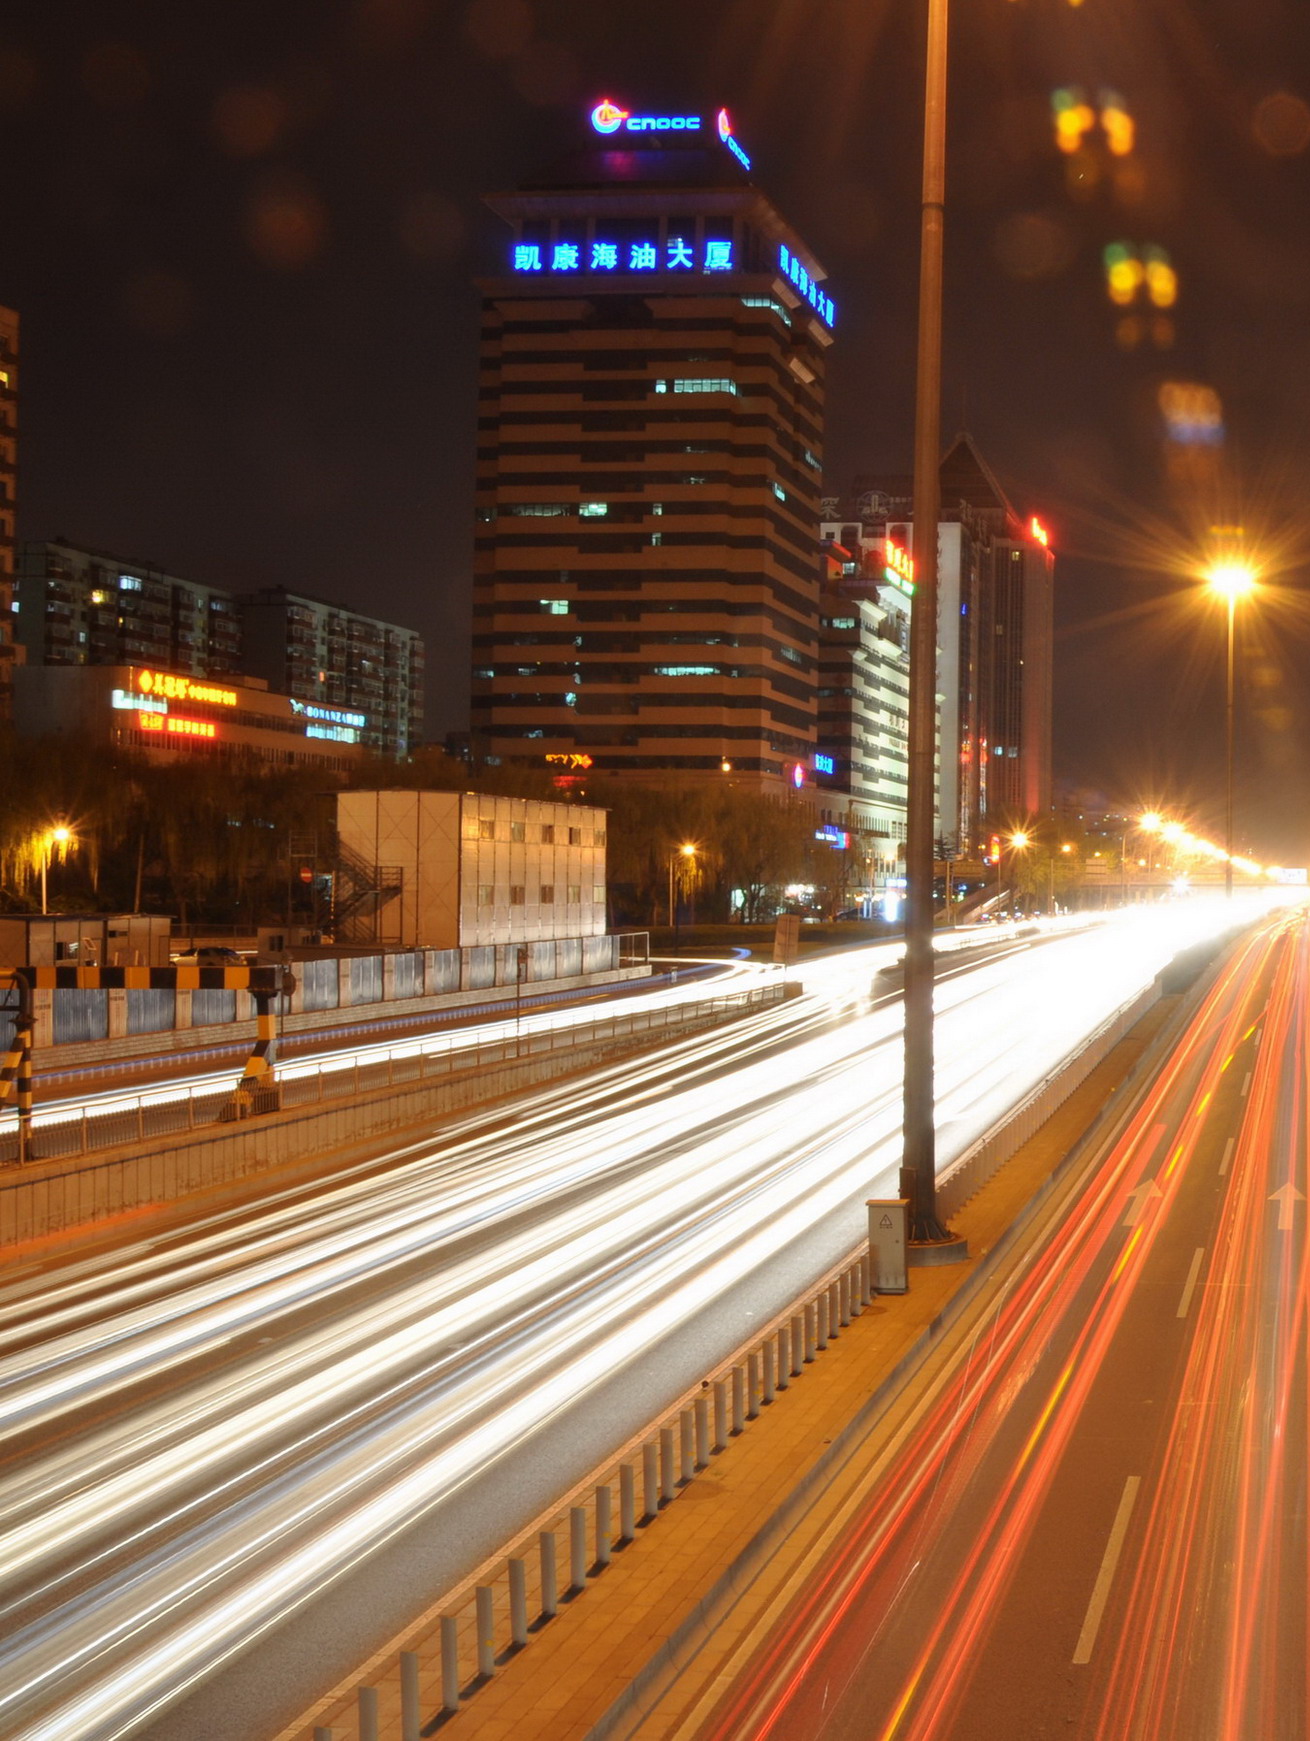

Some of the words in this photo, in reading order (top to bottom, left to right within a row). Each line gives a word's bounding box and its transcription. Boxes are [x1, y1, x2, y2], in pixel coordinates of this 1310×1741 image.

[514, 242, 733, 270] 凯康海油大厦
